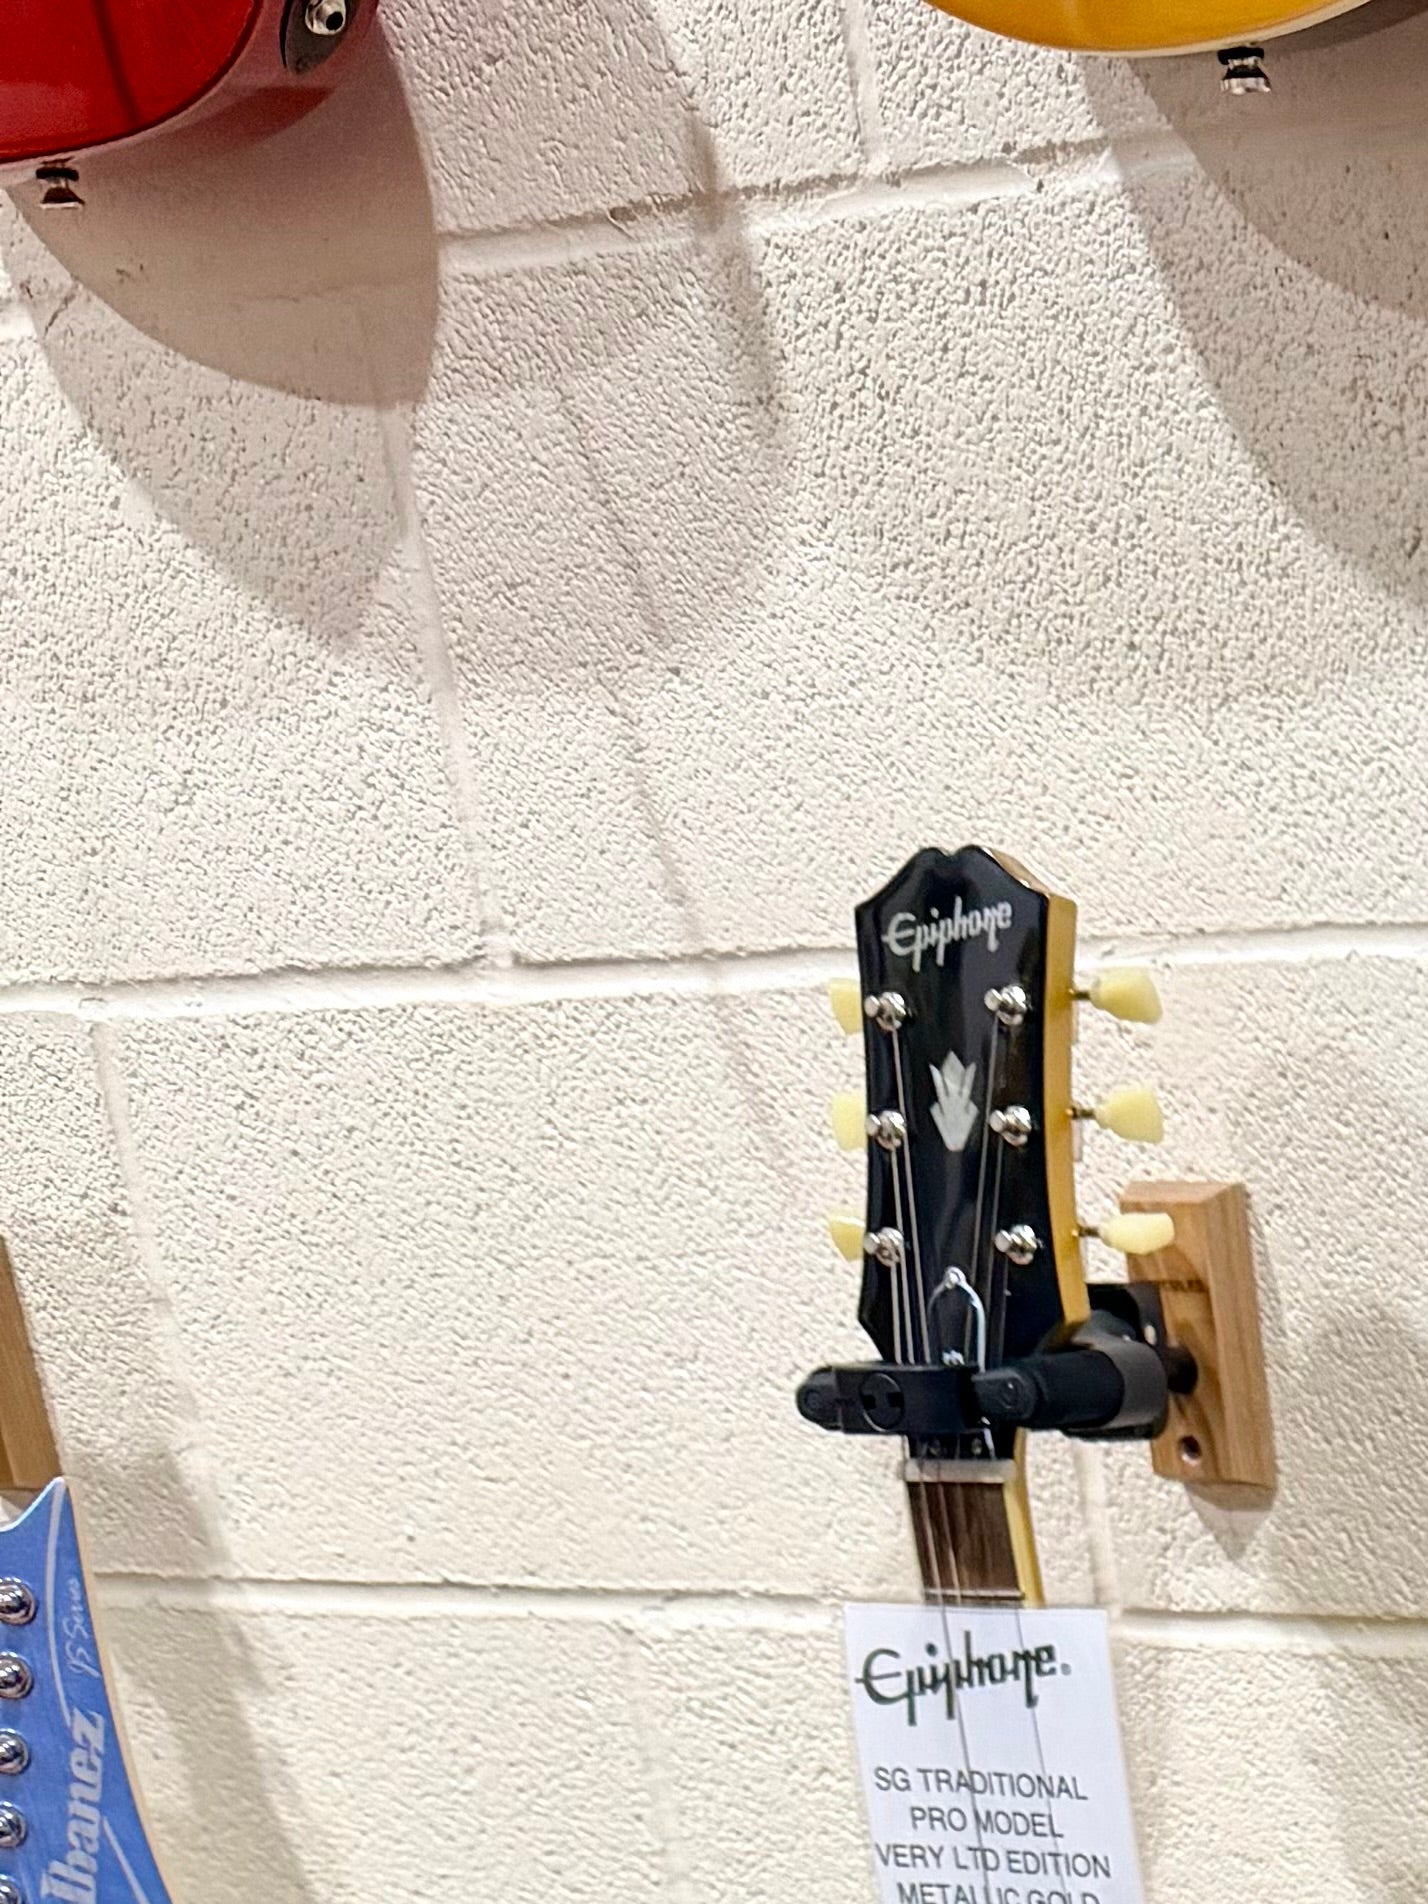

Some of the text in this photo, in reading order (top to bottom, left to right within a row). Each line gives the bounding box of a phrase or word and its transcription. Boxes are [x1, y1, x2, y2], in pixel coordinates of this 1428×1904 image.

[881, 895, 1012, 973] Epiphone
[854, 1631, 1057, 1727] Epiphone
[874, 1766, 1089, 1800] SG TRADITIONAL
[910, 1806, 1064, 1838] PRO MODEL
[875, 1842, 1112, 1878] VERY LTD EDITION
